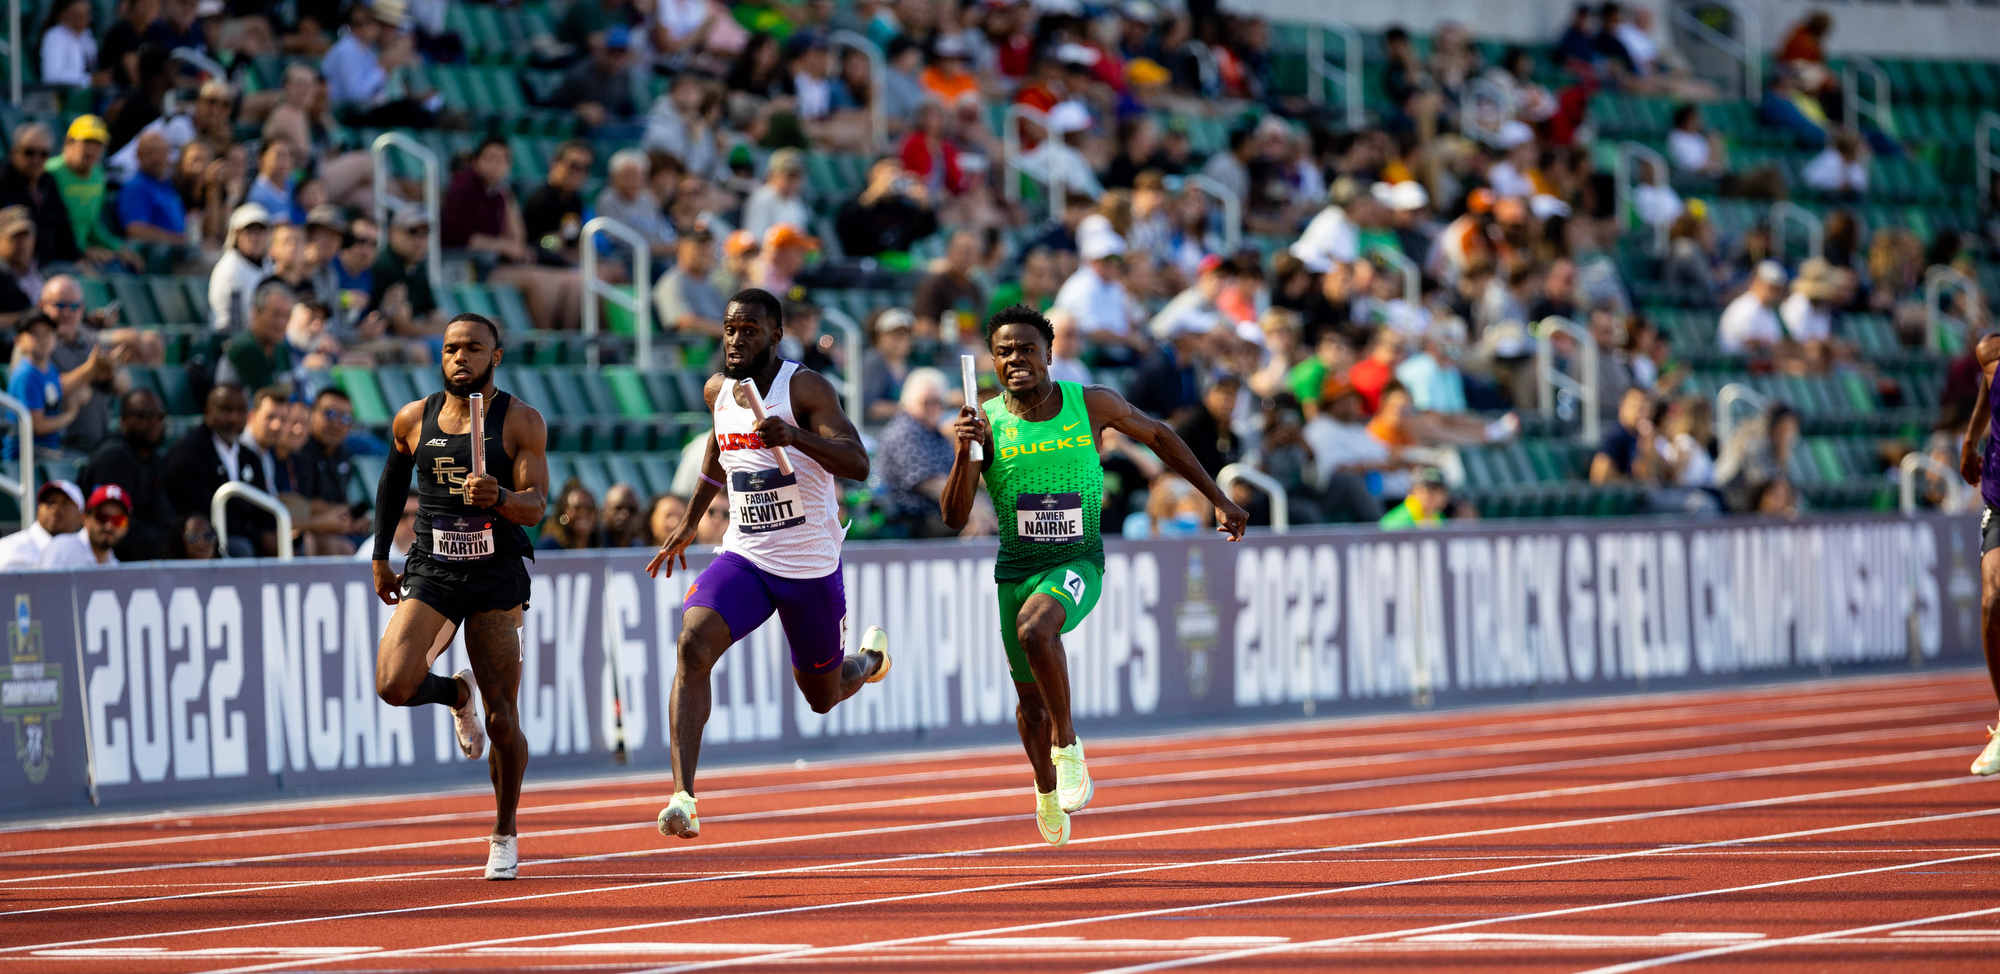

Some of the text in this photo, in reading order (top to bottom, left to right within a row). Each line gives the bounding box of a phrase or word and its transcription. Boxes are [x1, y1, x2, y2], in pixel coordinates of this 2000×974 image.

[425, 438, 448, 447] ACC
[718, 432, 765, 451] CLEMS
[1000, 435, 1092, 459] DUCKS
[745, 491, 779, 504] FABIAN
[740, 500, 794, 523] HEWITT
[1035, 511, 1064, 520] XAVIER
[1024, 520, 1076, 535] NAIRNE
[441, 531, 483, 542] JOVAUGHN
[439, 540, 488, 555] MARTIN
[1068, 577, 1082, 597] 4
[1234, 521, 1943, 707] 2022 NCAA TRACK & FIELD CHAMPIONSHIPS
[85, 585, 249, 785] 2022
[602, 570, 648, 755] &
